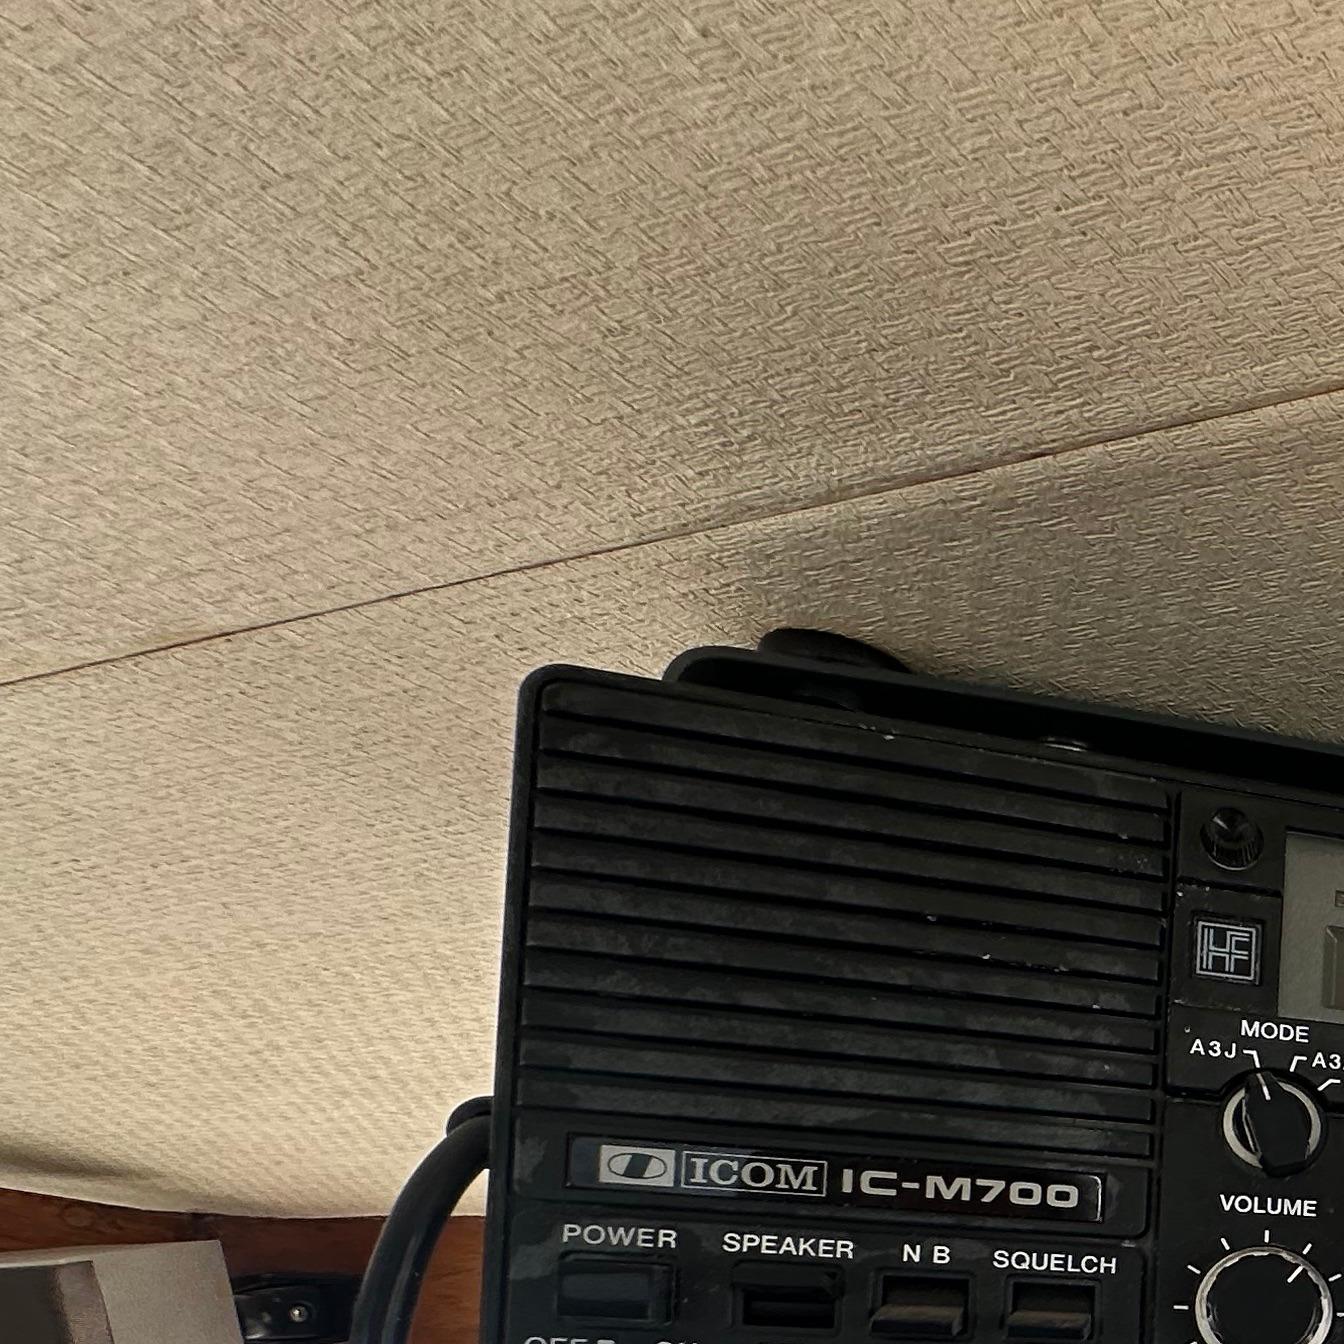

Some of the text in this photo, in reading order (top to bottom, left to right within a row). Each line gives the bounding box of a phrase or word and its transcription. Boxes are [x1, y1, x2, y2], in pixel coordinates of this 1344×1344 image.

[1240, 1020, 1310, 1043] MODE
[1190, 1038, 1237, 1059] A3J
[690, 1157, 1079, 1208] ICOM IC-M700
[1220, 1194, 1317, 1217] VOLUME
[561, 1223, 678, 1249] POWER
[722, 1232, 854, 1259] SPEAKER
[993, 1250, 1117, 1274] SQUELCH
